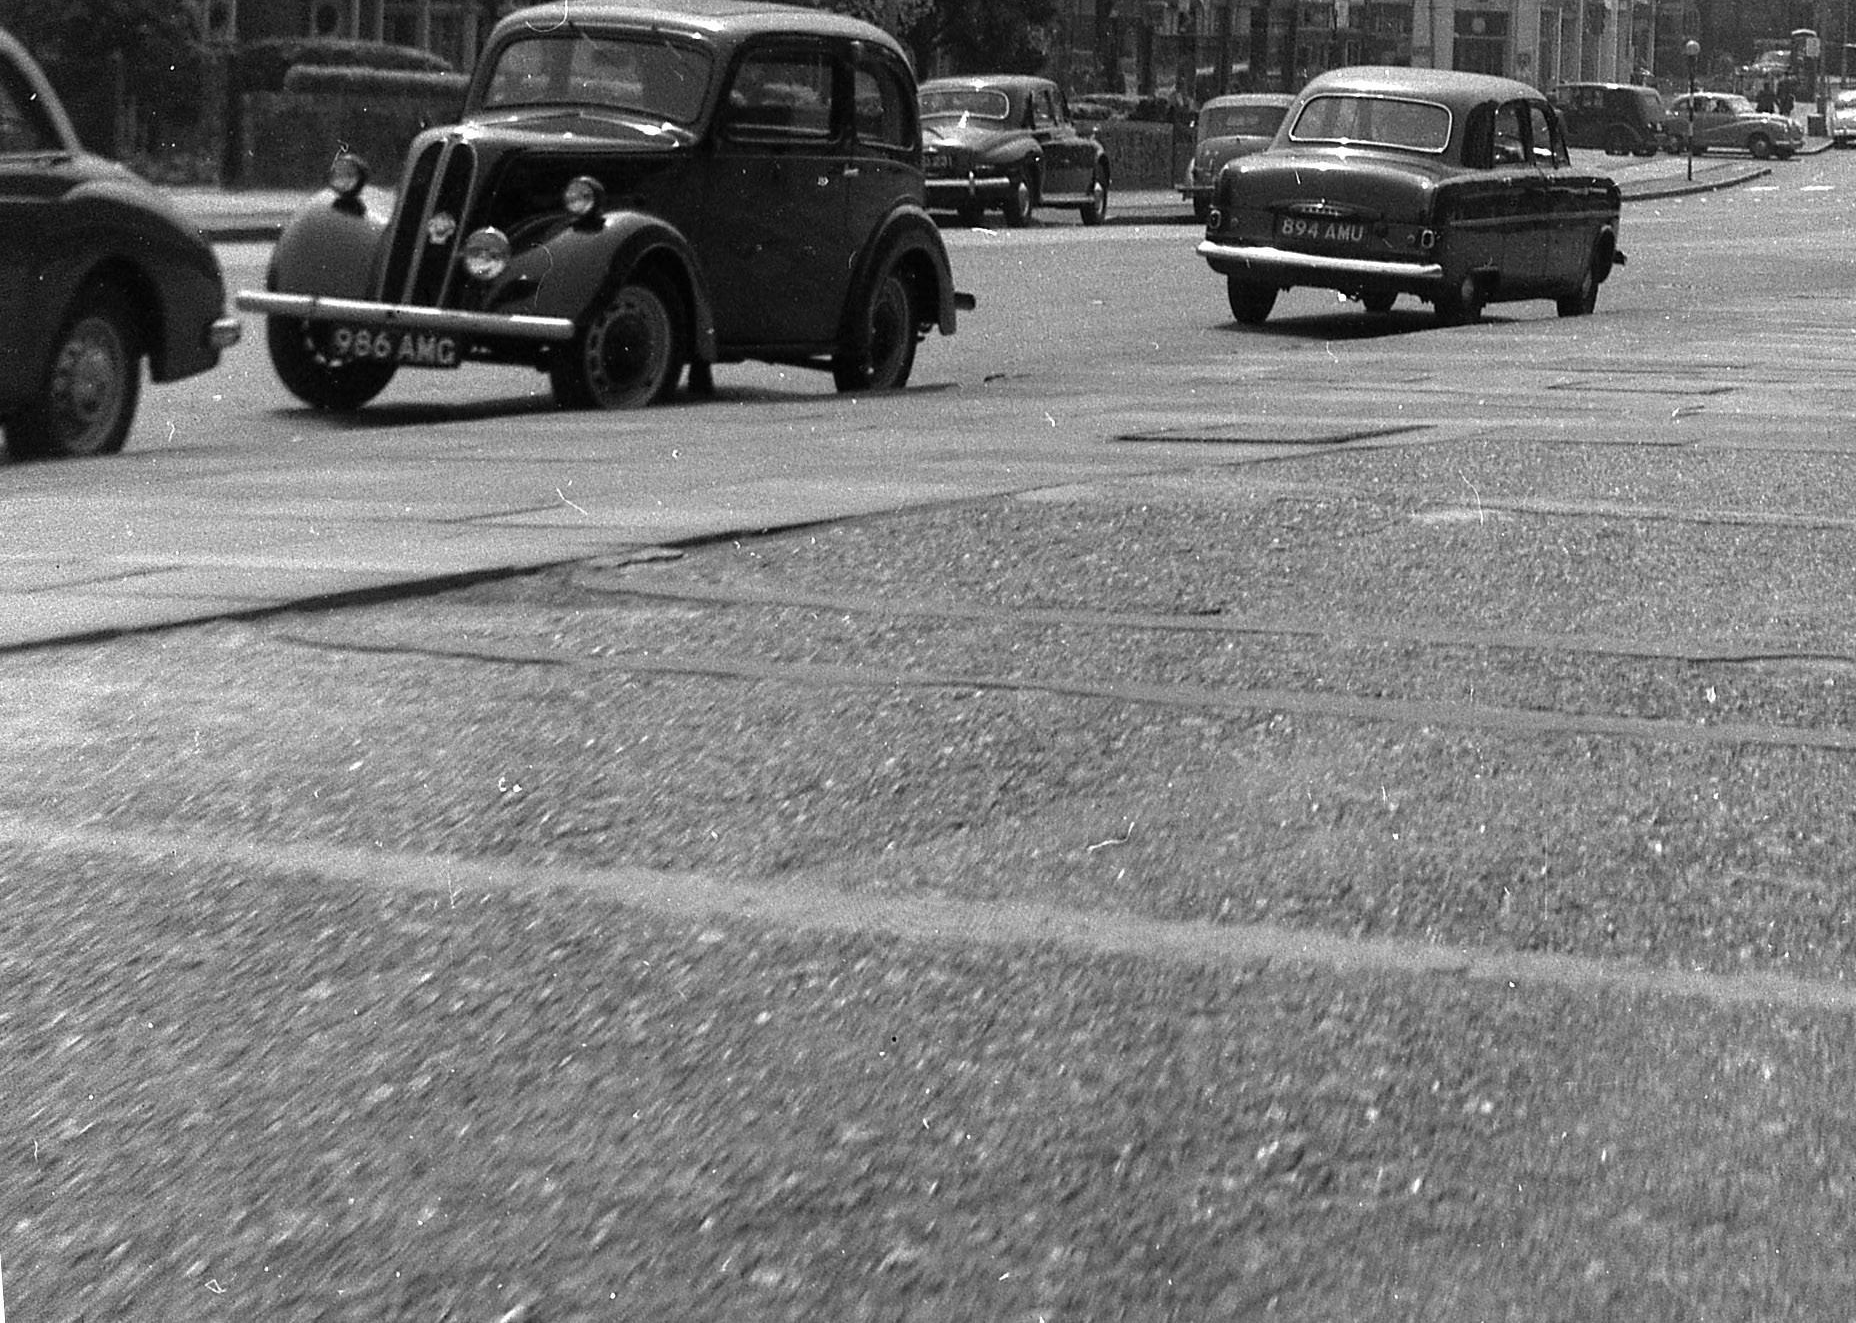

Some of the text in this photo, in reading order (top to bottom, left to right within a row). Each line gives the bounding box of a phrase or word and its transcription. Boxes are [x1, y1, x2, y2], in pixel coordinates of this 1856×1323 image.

[1282, 217, 1364, 242] 894 AMU
[335, 328, 392, 358] 986
